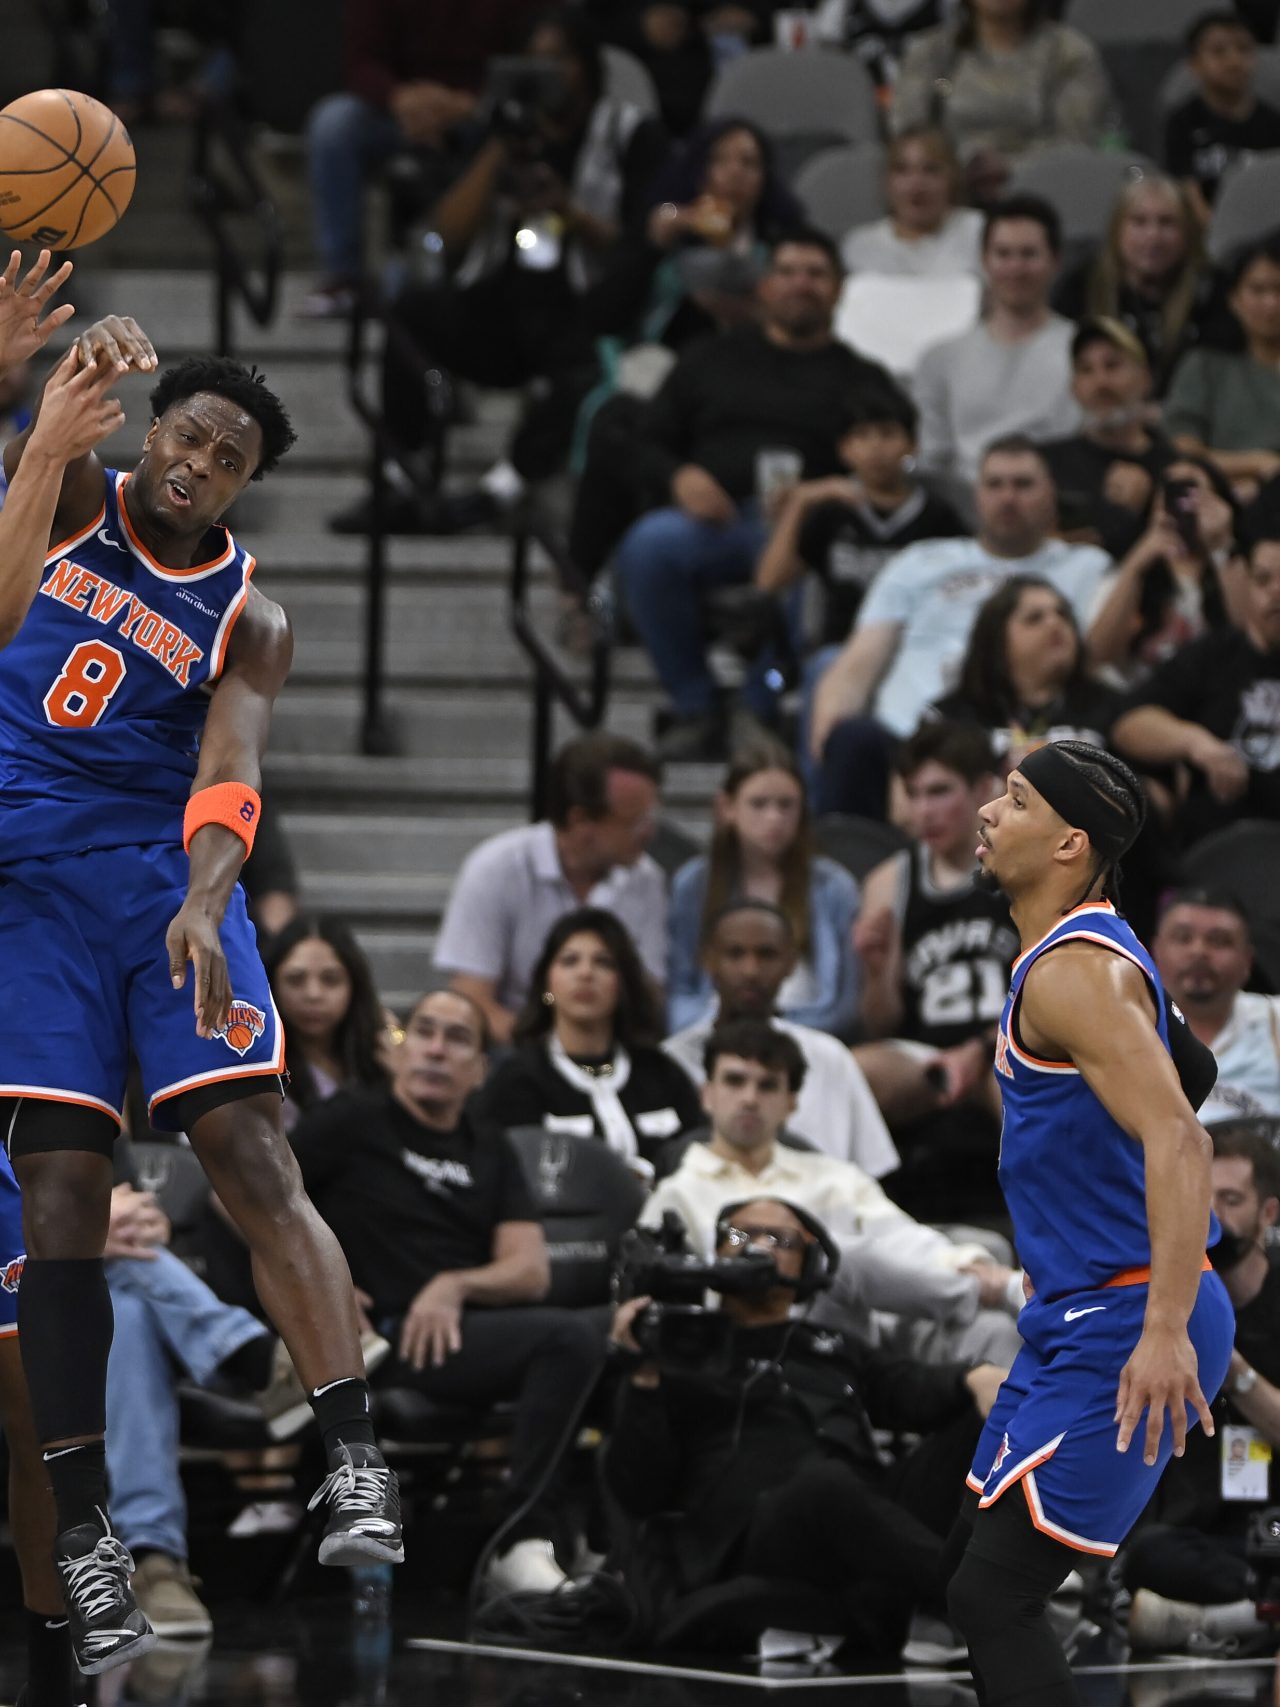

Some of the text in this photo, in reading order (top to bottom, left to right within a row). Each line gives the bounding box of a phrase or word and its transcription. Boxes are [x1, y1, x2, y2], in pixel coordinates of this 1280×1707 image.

[39, 558, 205, 690] NEW YORK
[43, 639, 127, 727] 8
[239, 801, 255, 822] 8
[224, 1007, 263, 1030] ICKS
[922, 959, 1006, 1024] 21
